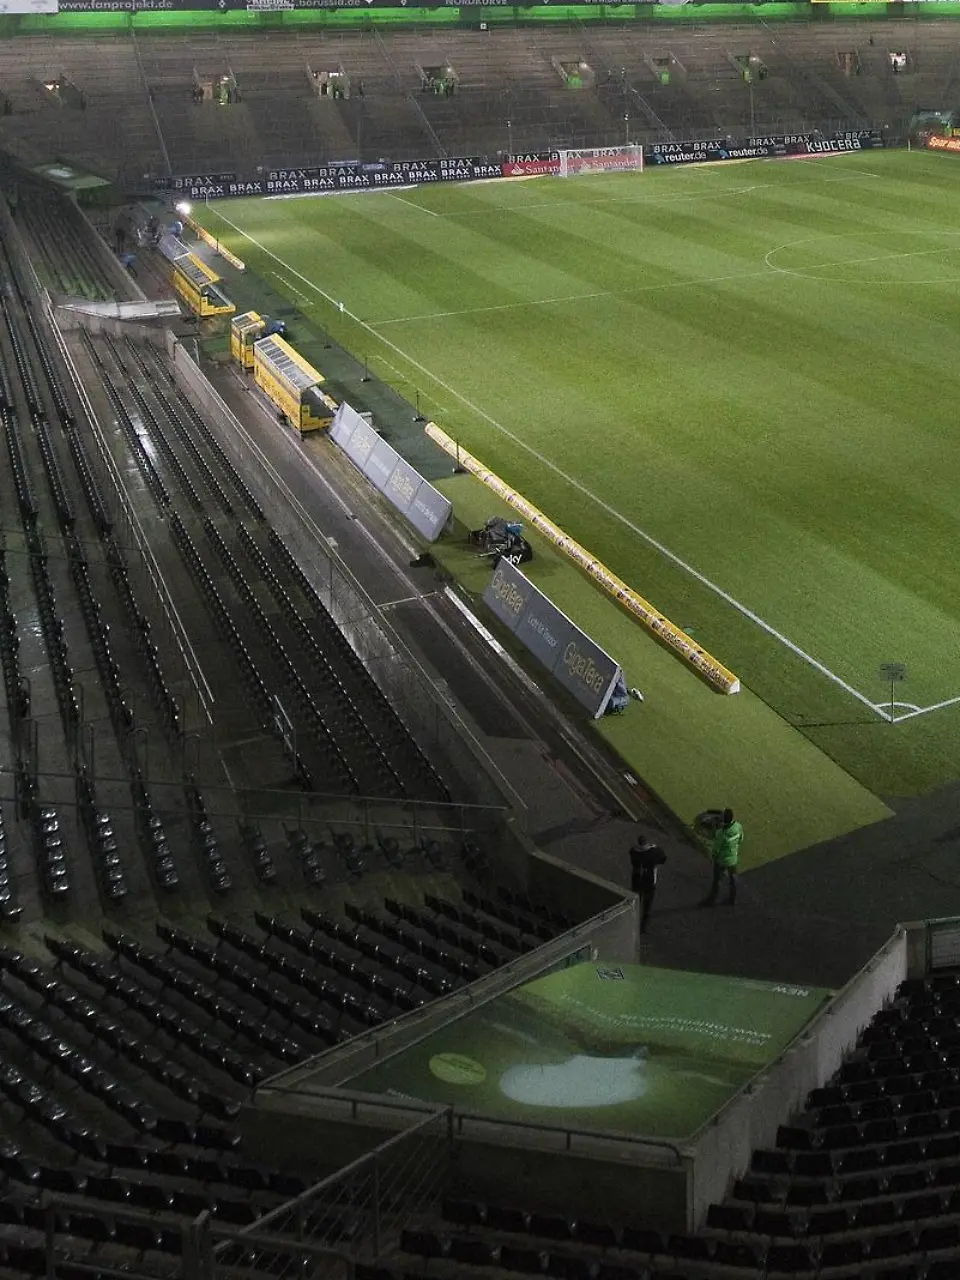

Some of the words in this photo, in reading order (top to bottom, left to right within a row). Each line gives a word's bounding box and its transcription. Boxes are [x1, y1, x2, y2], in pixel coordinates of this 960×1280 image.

[784, 134, 810, 144] BRAX
[845, 131, 871, 139] BRAX
[693, 141, 721, 151] BRAX
[749, 137, 776, 147] BRAX
[928, 135, 947, 148] Spar
[653, 144, 683, 153] BRAX
[728, 147, 768, 158] reuter.de
[508, 153, 540, 163] BRAX
[664, 151, 707, 162] reuter.de
[393, 162, 428, 172] BRAX
[440, 158, 473, 169] BRAX
[319, 166, 355, 177] BRAX
[408, 170, 437, 179] BRAX
[441, 167, 470, 177] BRAX
[474, 165, 501, 174] BRAX
[269, 170, 307, 180] BRAX
[339, 175, 369, 184] BRAX
[374, 172, 403, 181] BRAX
[175, 176, 214, 188] BRAX
[229, 182, 261, 192] BRAX
[267, 180, 298, 189] BRAX
[303, 178, 335, 187] BRAX
[191, 185, 224, 195] BRAX
[563, 640, 604, 694] GigaTera
